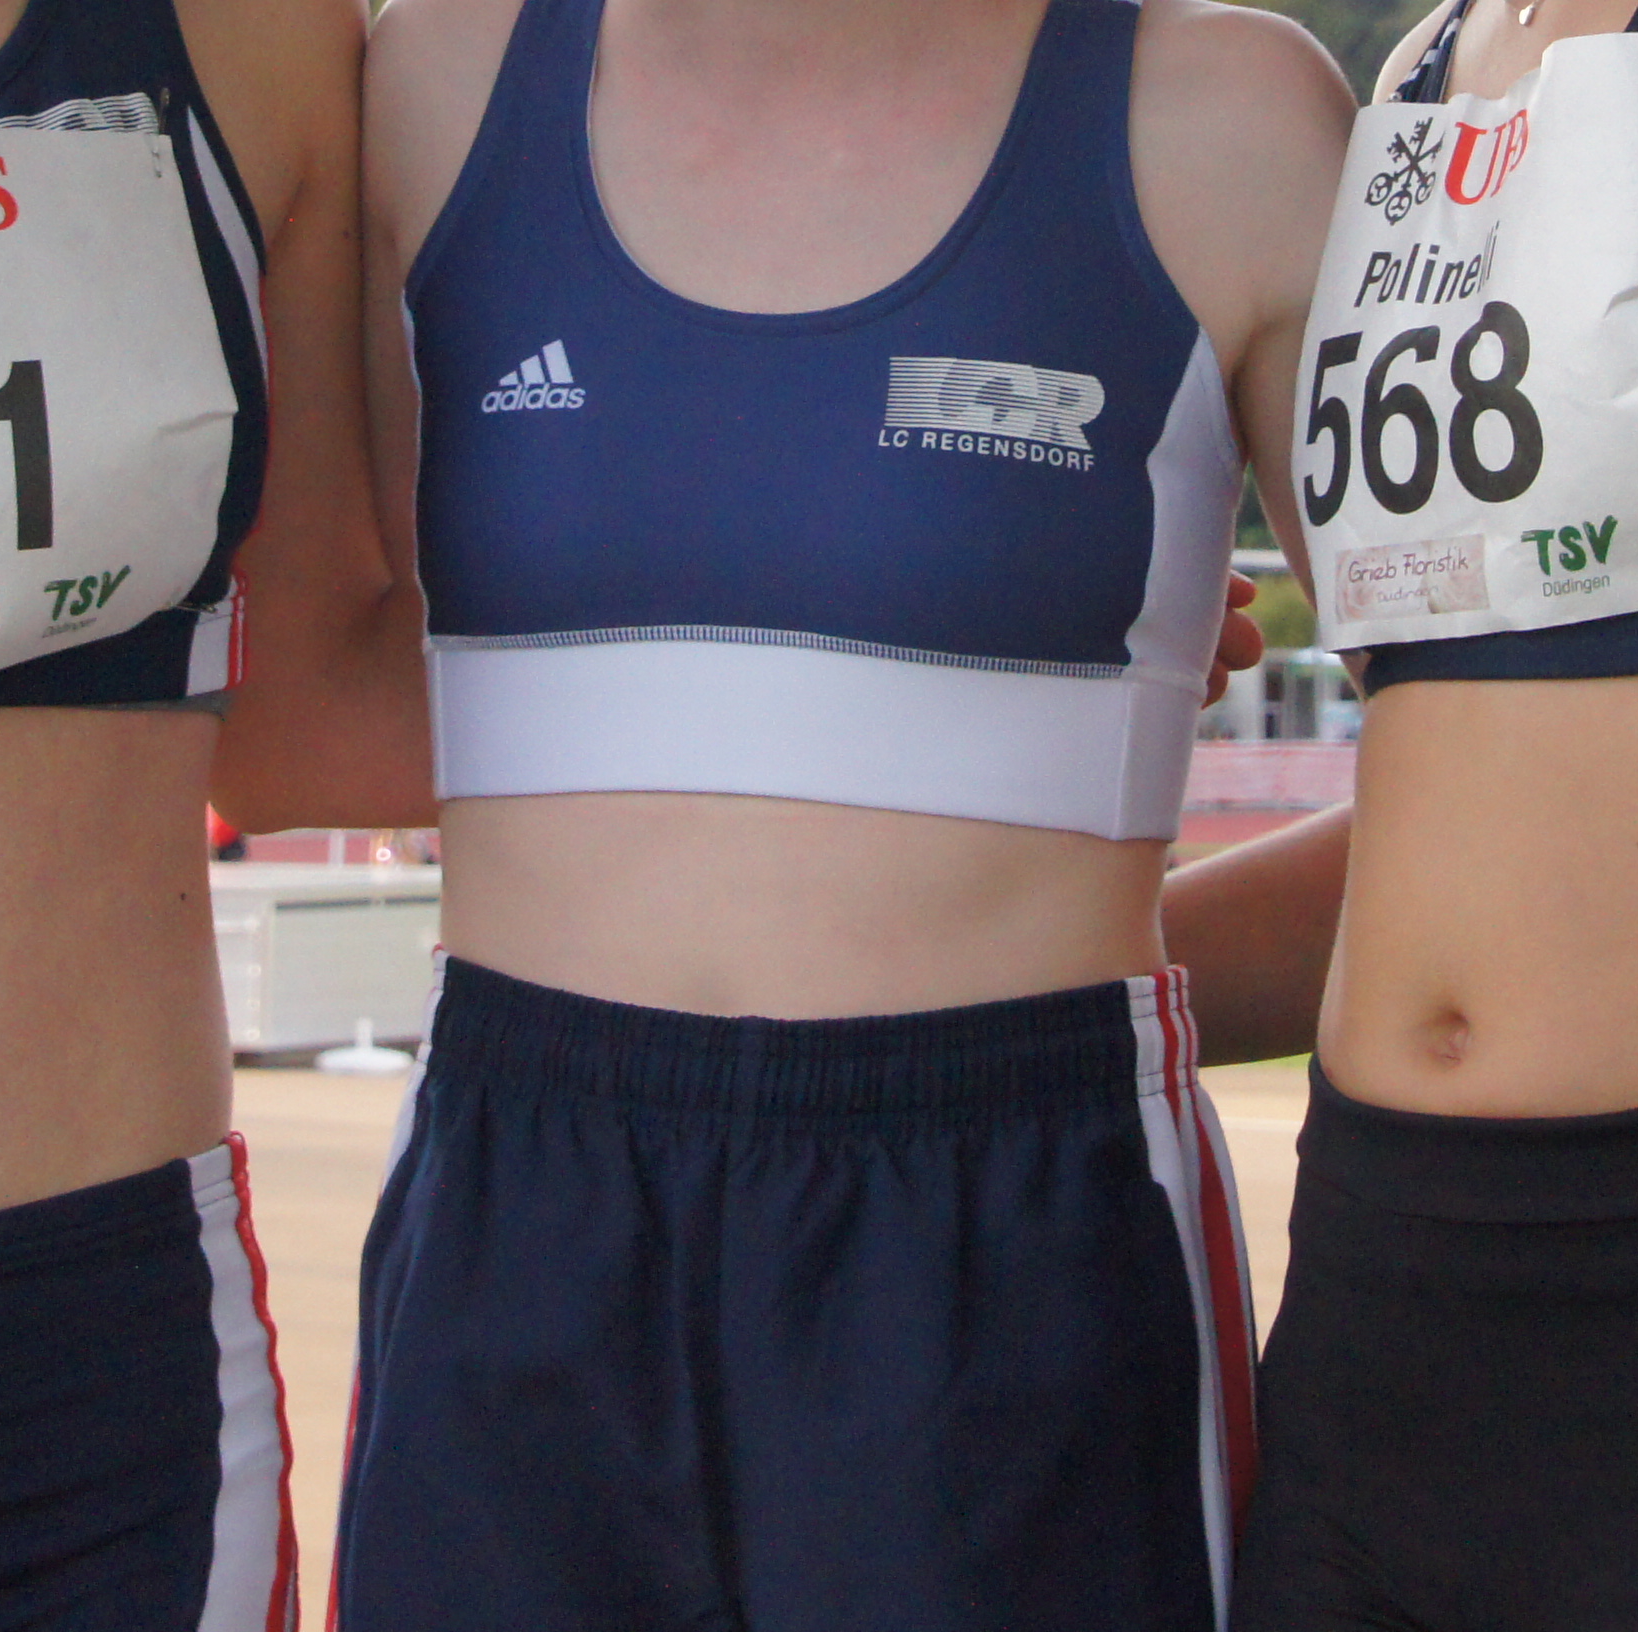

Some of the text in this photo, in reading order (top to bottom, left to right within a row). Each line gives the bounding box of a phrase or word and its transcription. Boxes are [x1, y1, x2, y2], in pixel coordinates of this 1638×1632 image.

[1444, 108, 1530, 206] UB
[481, 381, 585, 414] adidas
[1303, 301, 1544, 527] 568
[878, 428, 1095, 472] LC REGENSDORF
[1403, 549, 1469, 576] Floristik
[1521, 515, 1618, 577] TSV
[44, 564, 131, 621] TSV
[1542, 574, 1610, 598] Düdingen
